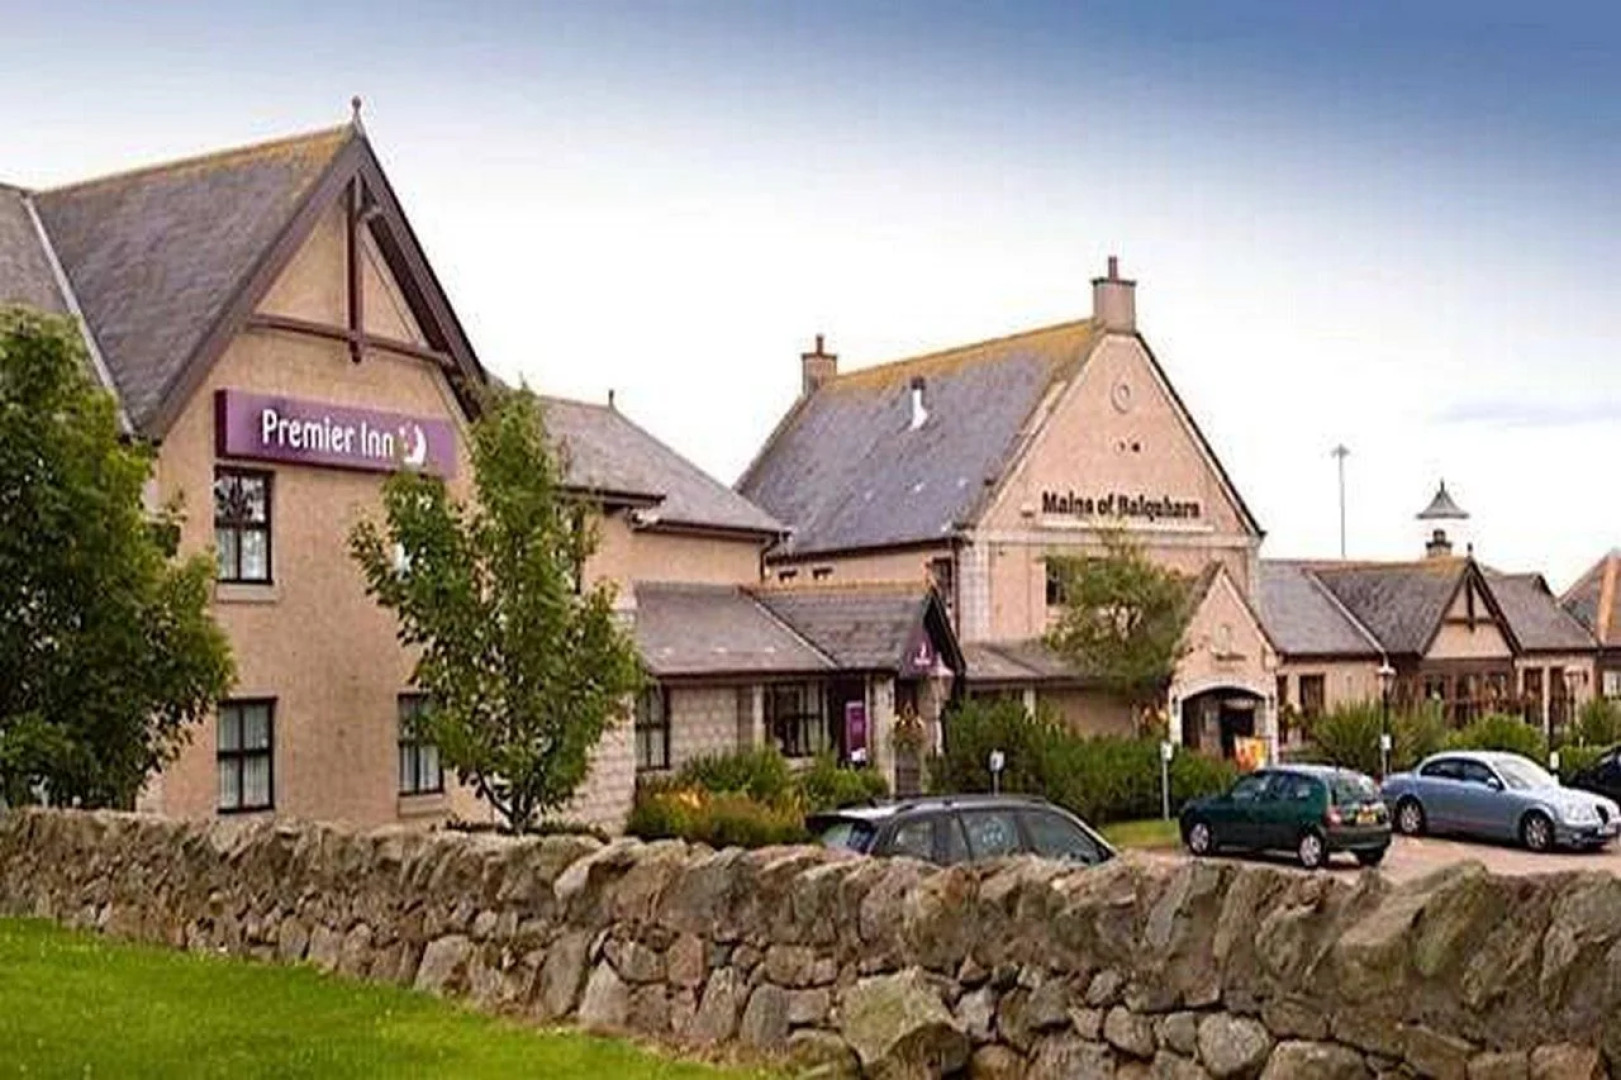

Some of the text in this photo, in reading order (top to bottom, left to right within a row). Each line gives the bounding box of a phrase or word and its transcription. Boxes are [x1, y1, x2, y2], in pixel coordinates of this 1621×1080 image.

[261, 408, 395, 457] Premier Inn
[1041, 490, 1094, 515] Mains
[1097, 492, 1114, 517] of
